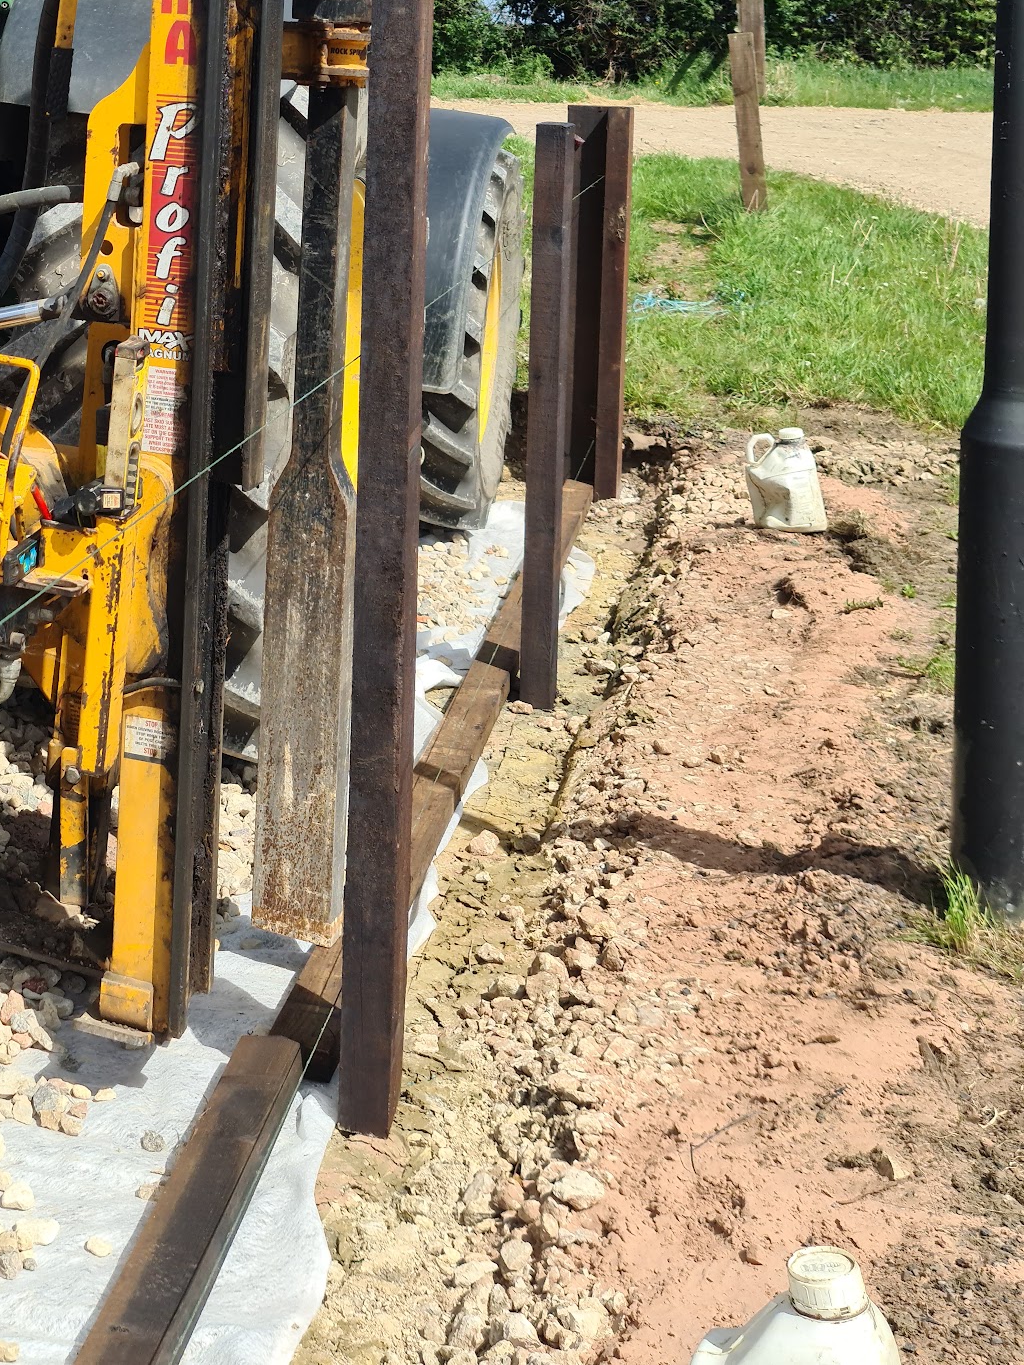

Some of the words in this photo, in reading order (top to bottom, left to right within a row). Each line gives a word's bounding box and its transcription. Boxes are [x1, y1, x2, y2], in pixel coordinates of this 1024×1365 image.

[138, 328, 194, 351] MAX
[148, 349, 192, 362] AGNUM
[143, 747, 158, 757] STOP
